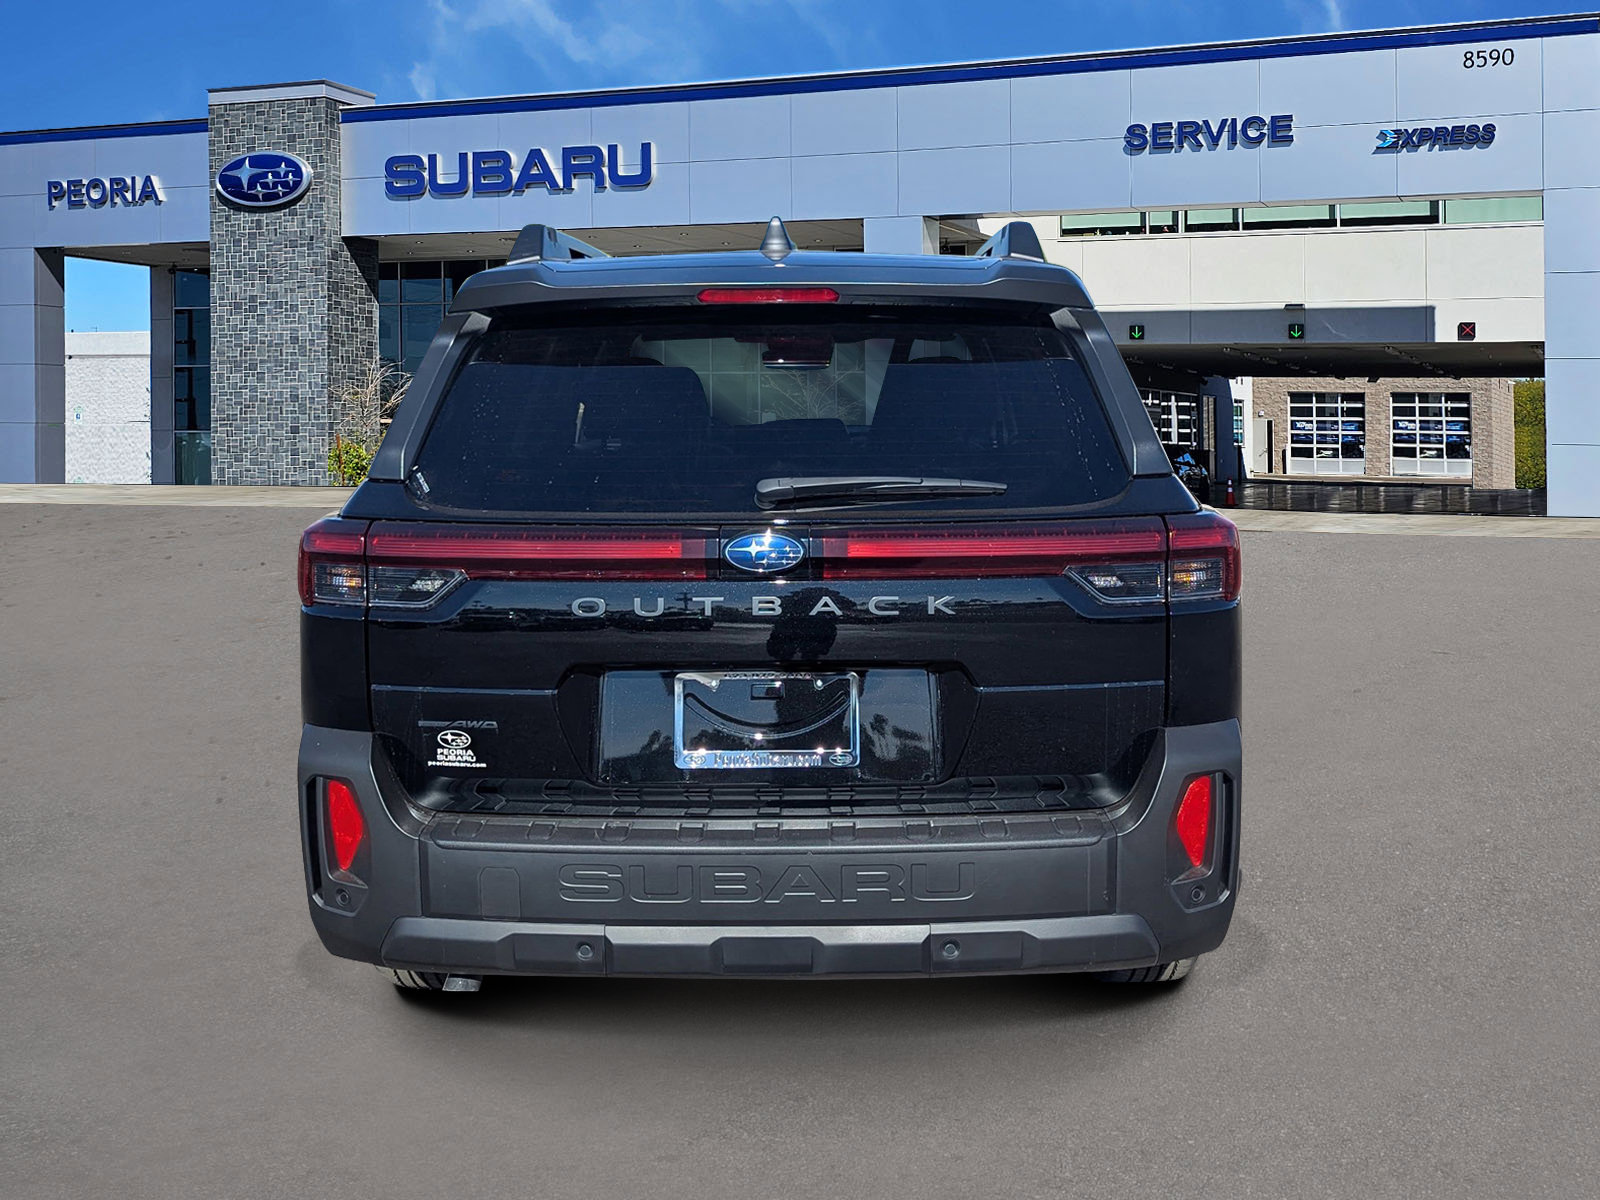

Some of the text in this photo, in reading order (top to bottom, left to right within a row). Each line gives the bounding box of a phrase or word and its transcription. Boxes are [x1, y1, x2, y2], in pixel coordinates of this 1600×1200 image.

[1463, 48, 1515, 69] 8590
[1124, 114, 1294, 152] SERVICE
[1375, 123, 1497, 150] EXPRESS
[384, 141, 653, 199] SUBARU
[47, 175, 163, 209] PEORIA
[571, 595, 956, 617] OUTBACK
[448, 720, 498, 728] AWD
[436, 748, 474, 756] PEORIA
[558, 863, 977, 903] SUBARU
